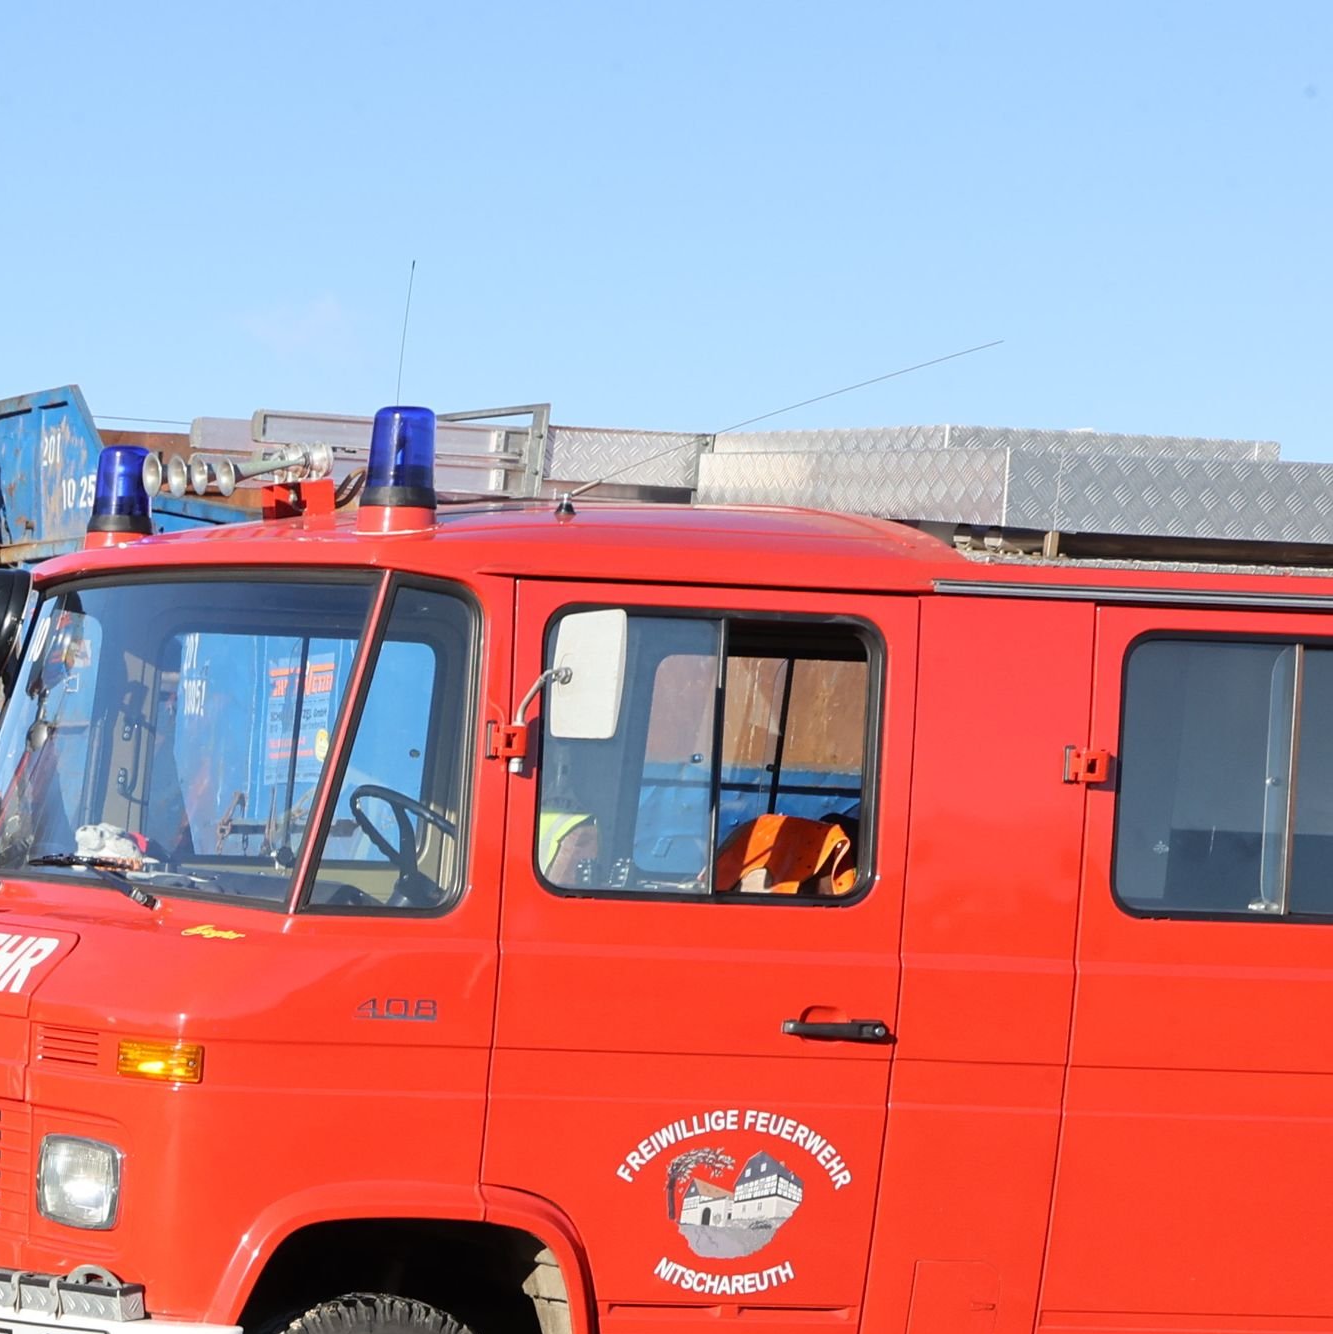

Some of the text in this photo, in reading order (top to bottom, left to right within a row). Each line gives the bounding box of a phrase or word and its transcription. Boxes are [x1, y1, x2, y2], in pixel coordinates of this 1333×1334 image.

[355, 998, 437, 1021] 408
[616, 1110, 852, 1190] FREIWILLIGE FEUERWEHR
[653, 1257, 795, 1295] NITSCHAREUTH
